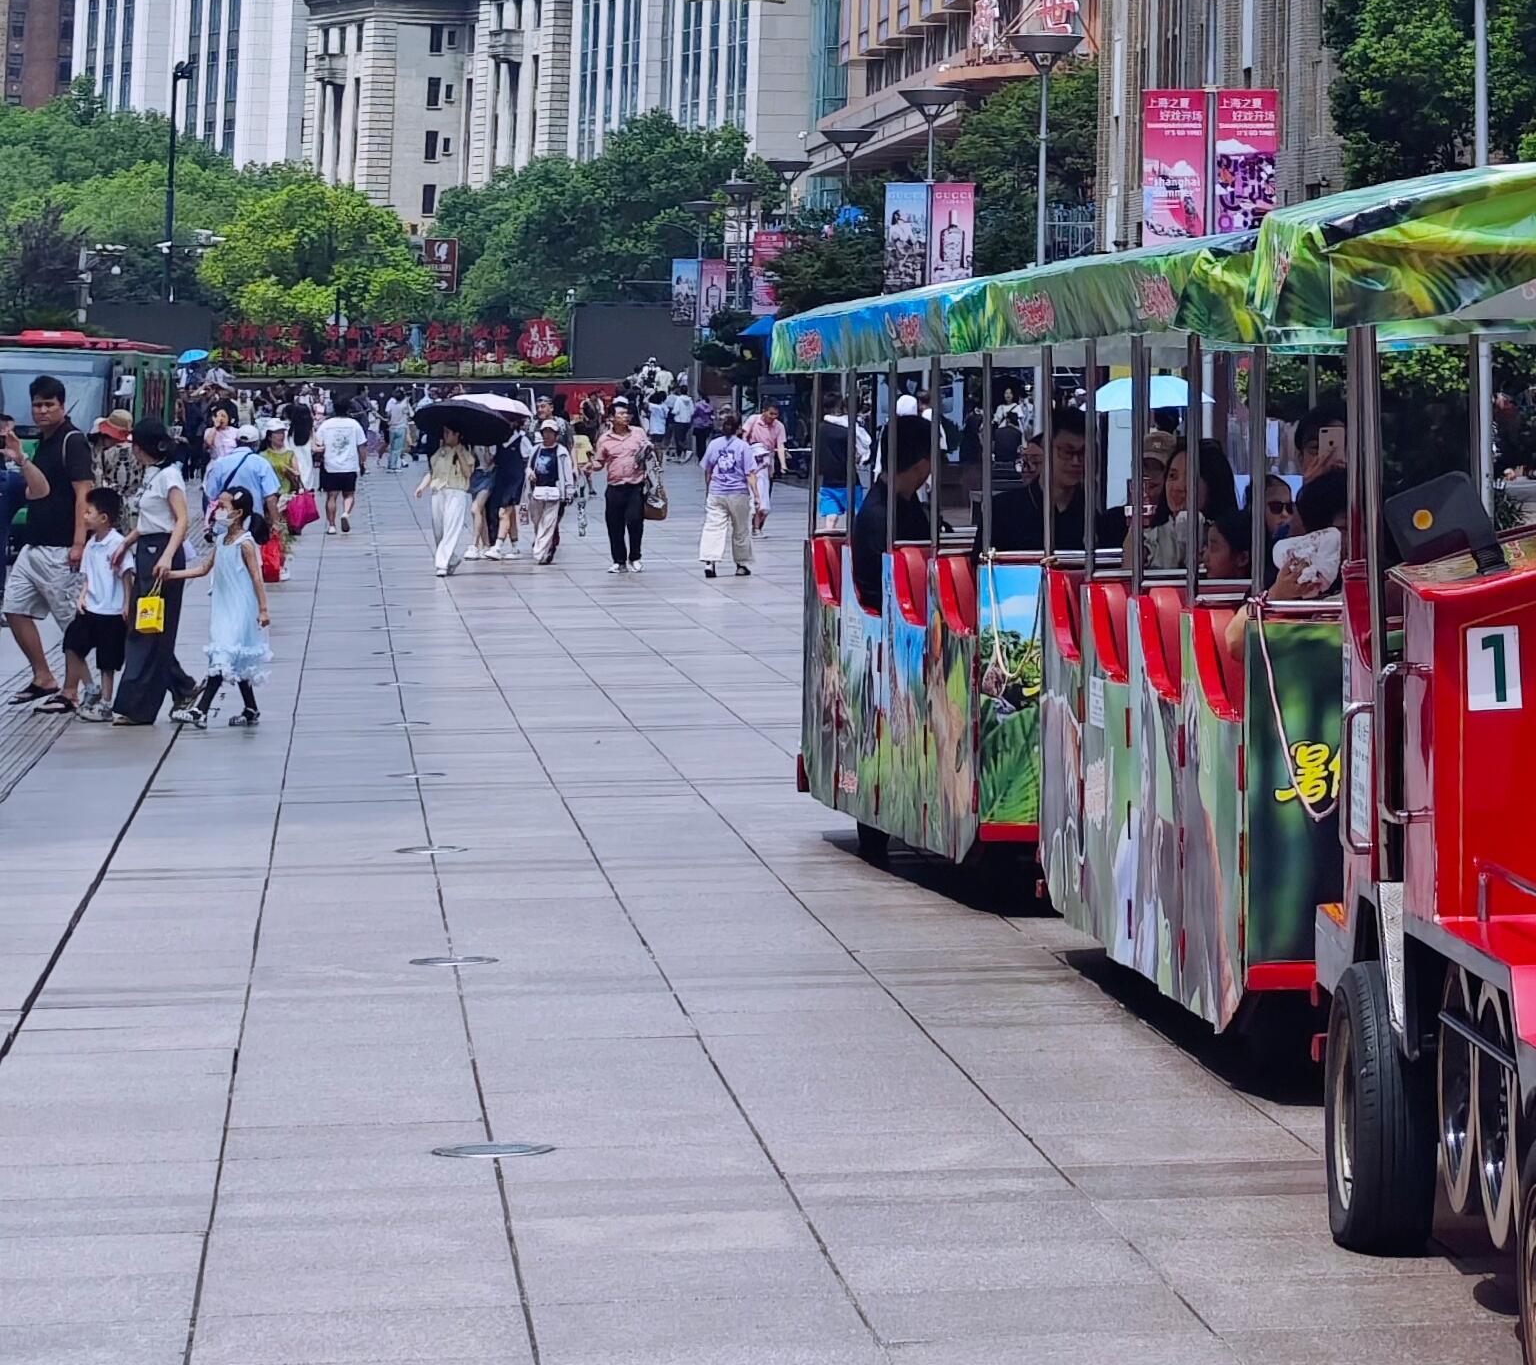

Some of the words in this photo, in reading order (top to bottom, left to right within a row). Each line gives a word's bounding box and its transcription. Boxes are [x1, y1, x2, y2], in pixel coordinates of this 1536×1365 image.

[1146, 97, 1190, 109] 上海之夏
[1219, 97, 1263, 109] 上海之夏
[1479, 634, 1509, 704] 1
